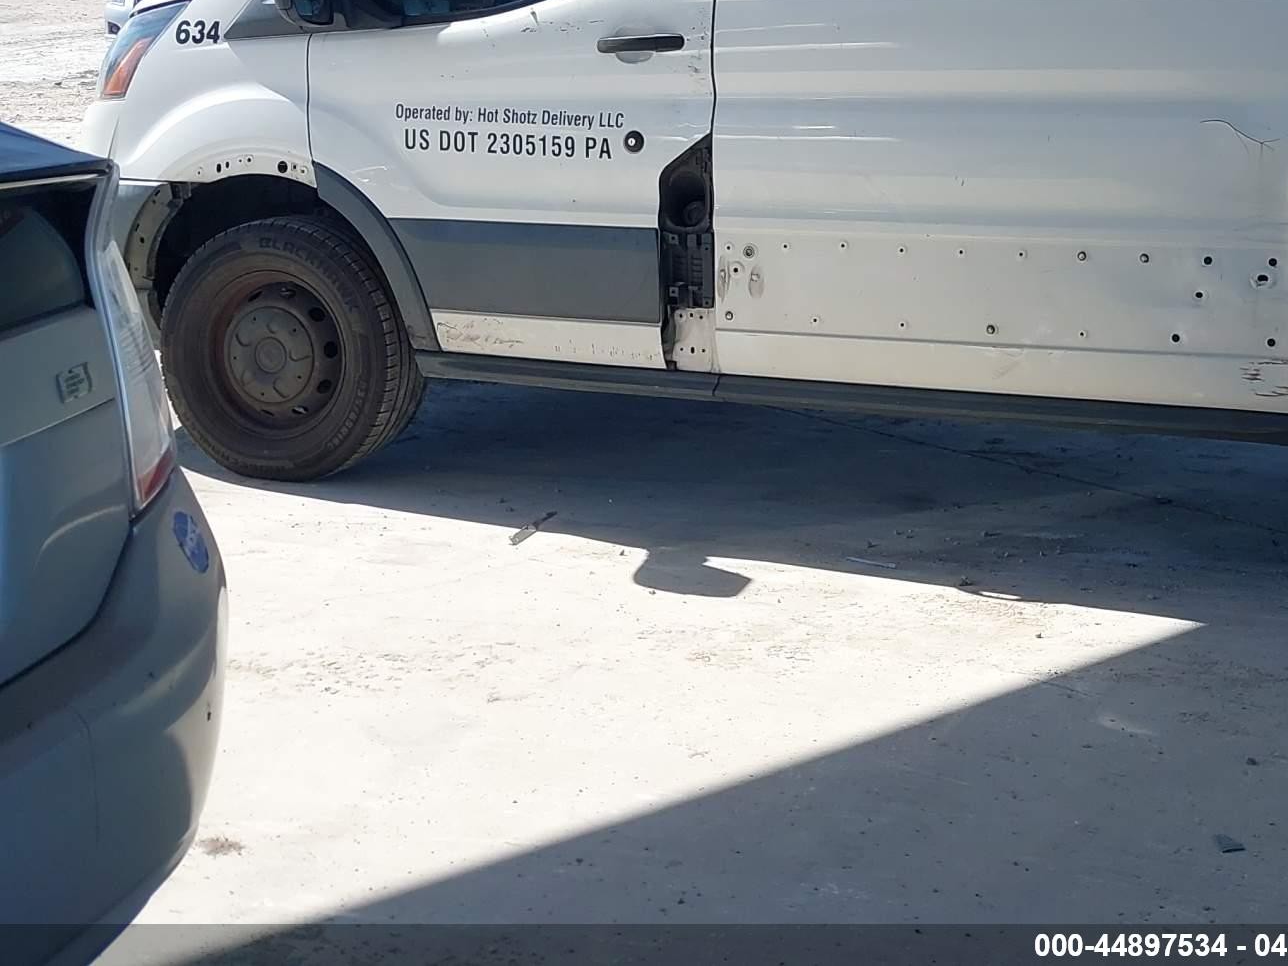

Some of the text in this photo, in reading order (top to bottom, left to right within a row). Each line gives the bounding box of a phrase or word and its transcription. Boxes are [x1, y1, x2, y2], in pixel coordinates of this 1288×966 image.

[175, 19, 220, 45] 634
[395, 103, 625, 130] Operated by: Hot Shotz Delivery LLC
[404, 128, 613, 160] US DOT 2305159 PA
